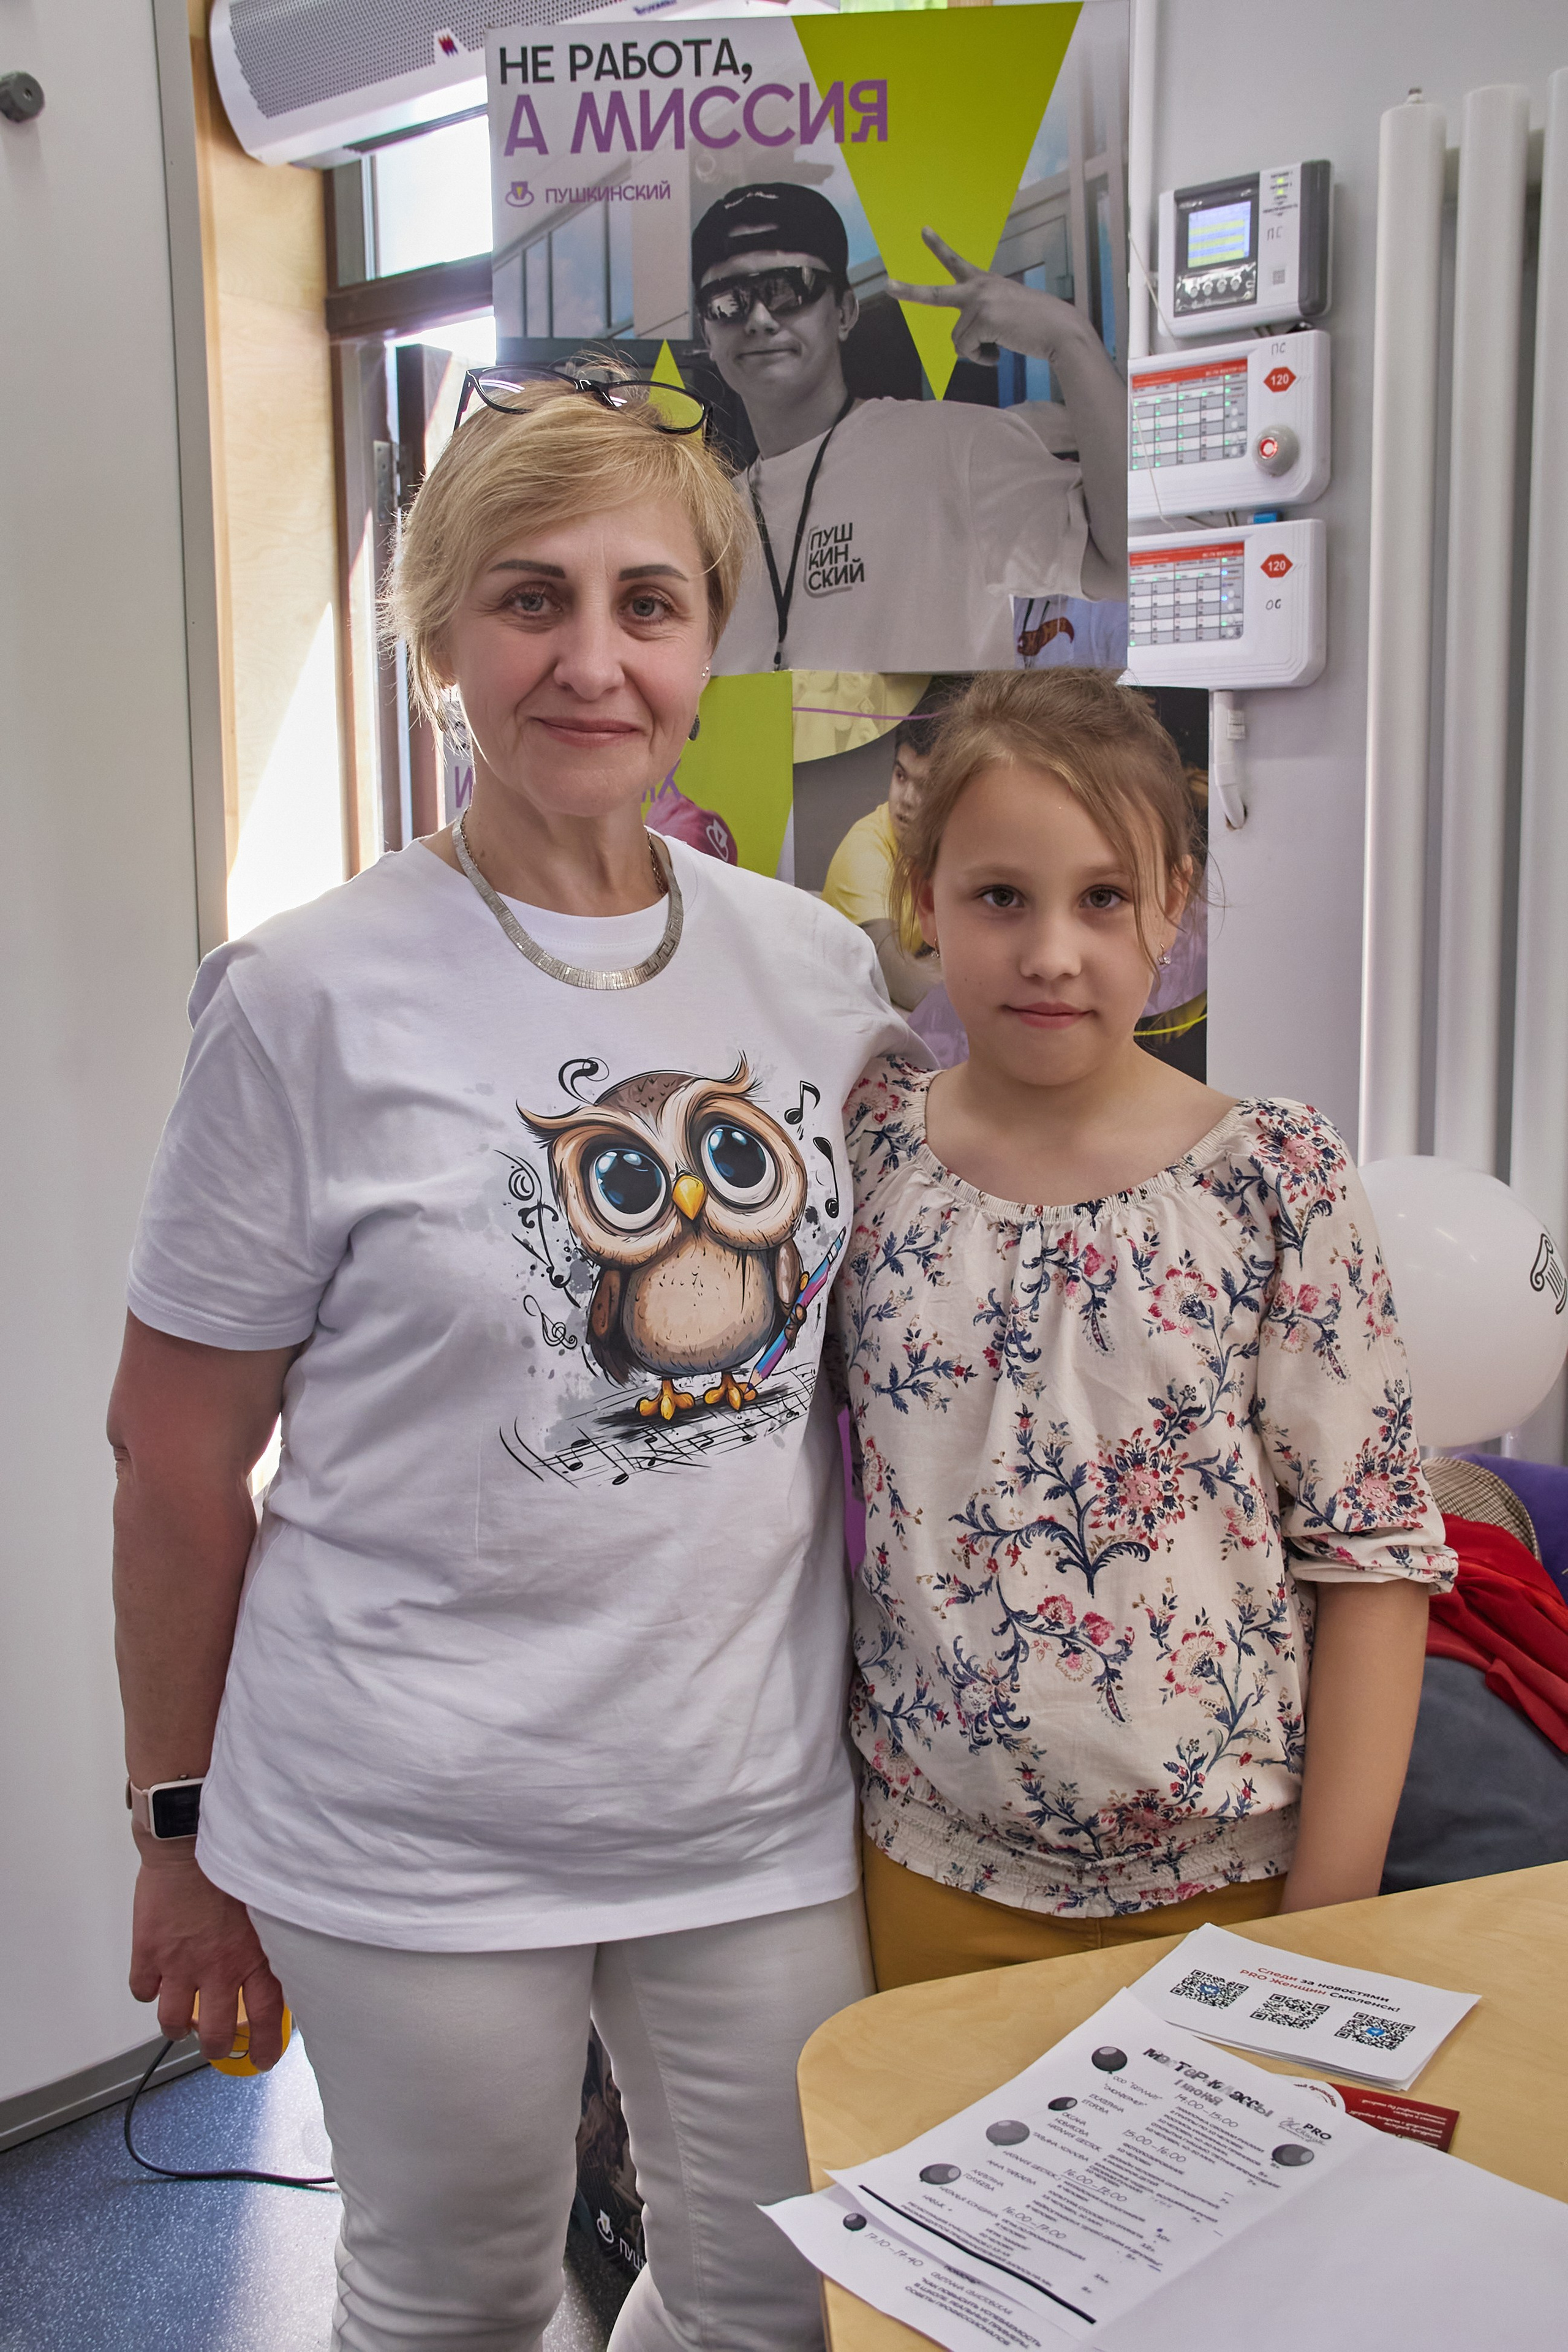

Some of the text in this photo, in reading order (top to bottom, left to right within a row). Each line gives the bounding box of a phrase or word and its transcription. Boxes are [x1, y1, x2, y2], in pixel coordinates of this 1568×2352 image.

[499, 37, 753, 85] НЕ РАБОТА,
[503, 79, 889, 156] А МИССИЯ
[545, 181, 671, 204] ПУШКИНСКИЙ
[1270, 374, 1289, 386] 120
[810, 522, 853, 551] ПУШ
[809, 543, 848, 570] КИН
[809, 557, 864, 590] СКИЙ
[1267, 560, 1286, 572] 120
[1240, 1969, 1401, 2013] PRO Женщин Смоленск!
[1257, 1967, 1298, 1981] Следи
[1317, 1982, 1390, 2002] новостями
[1081, 2098, 1109, 2114] ЕГОРОВА
[1088, 2094, 1125, 2113] ЕКАТЕРИНА
[1054, 2117, 1089, 2137] НОВИКОВА
[1061, 2112, 1087, 2127] ОКСАНА
[1300, 2122, 1332, 2141] PRO
[1216, 2133, 1244, 2150] ЧЕЛОВЕК
[1122, 2150, 1152, 2167] ЧЕЛОВЕК
[1091, 2171, 1120, 2188] ЧЕЛОВЕК
[1062, 2187, 1090, 2203] ЧЕЛОВЕК
[1028, 2206, 1058, 2223] ЧЕЛОВЕК
[1000, 2224, 1027, 2240] ЧЕЛОВЕК
[986, 2236, 1014, 2252] ЧЕЛОВЕК
